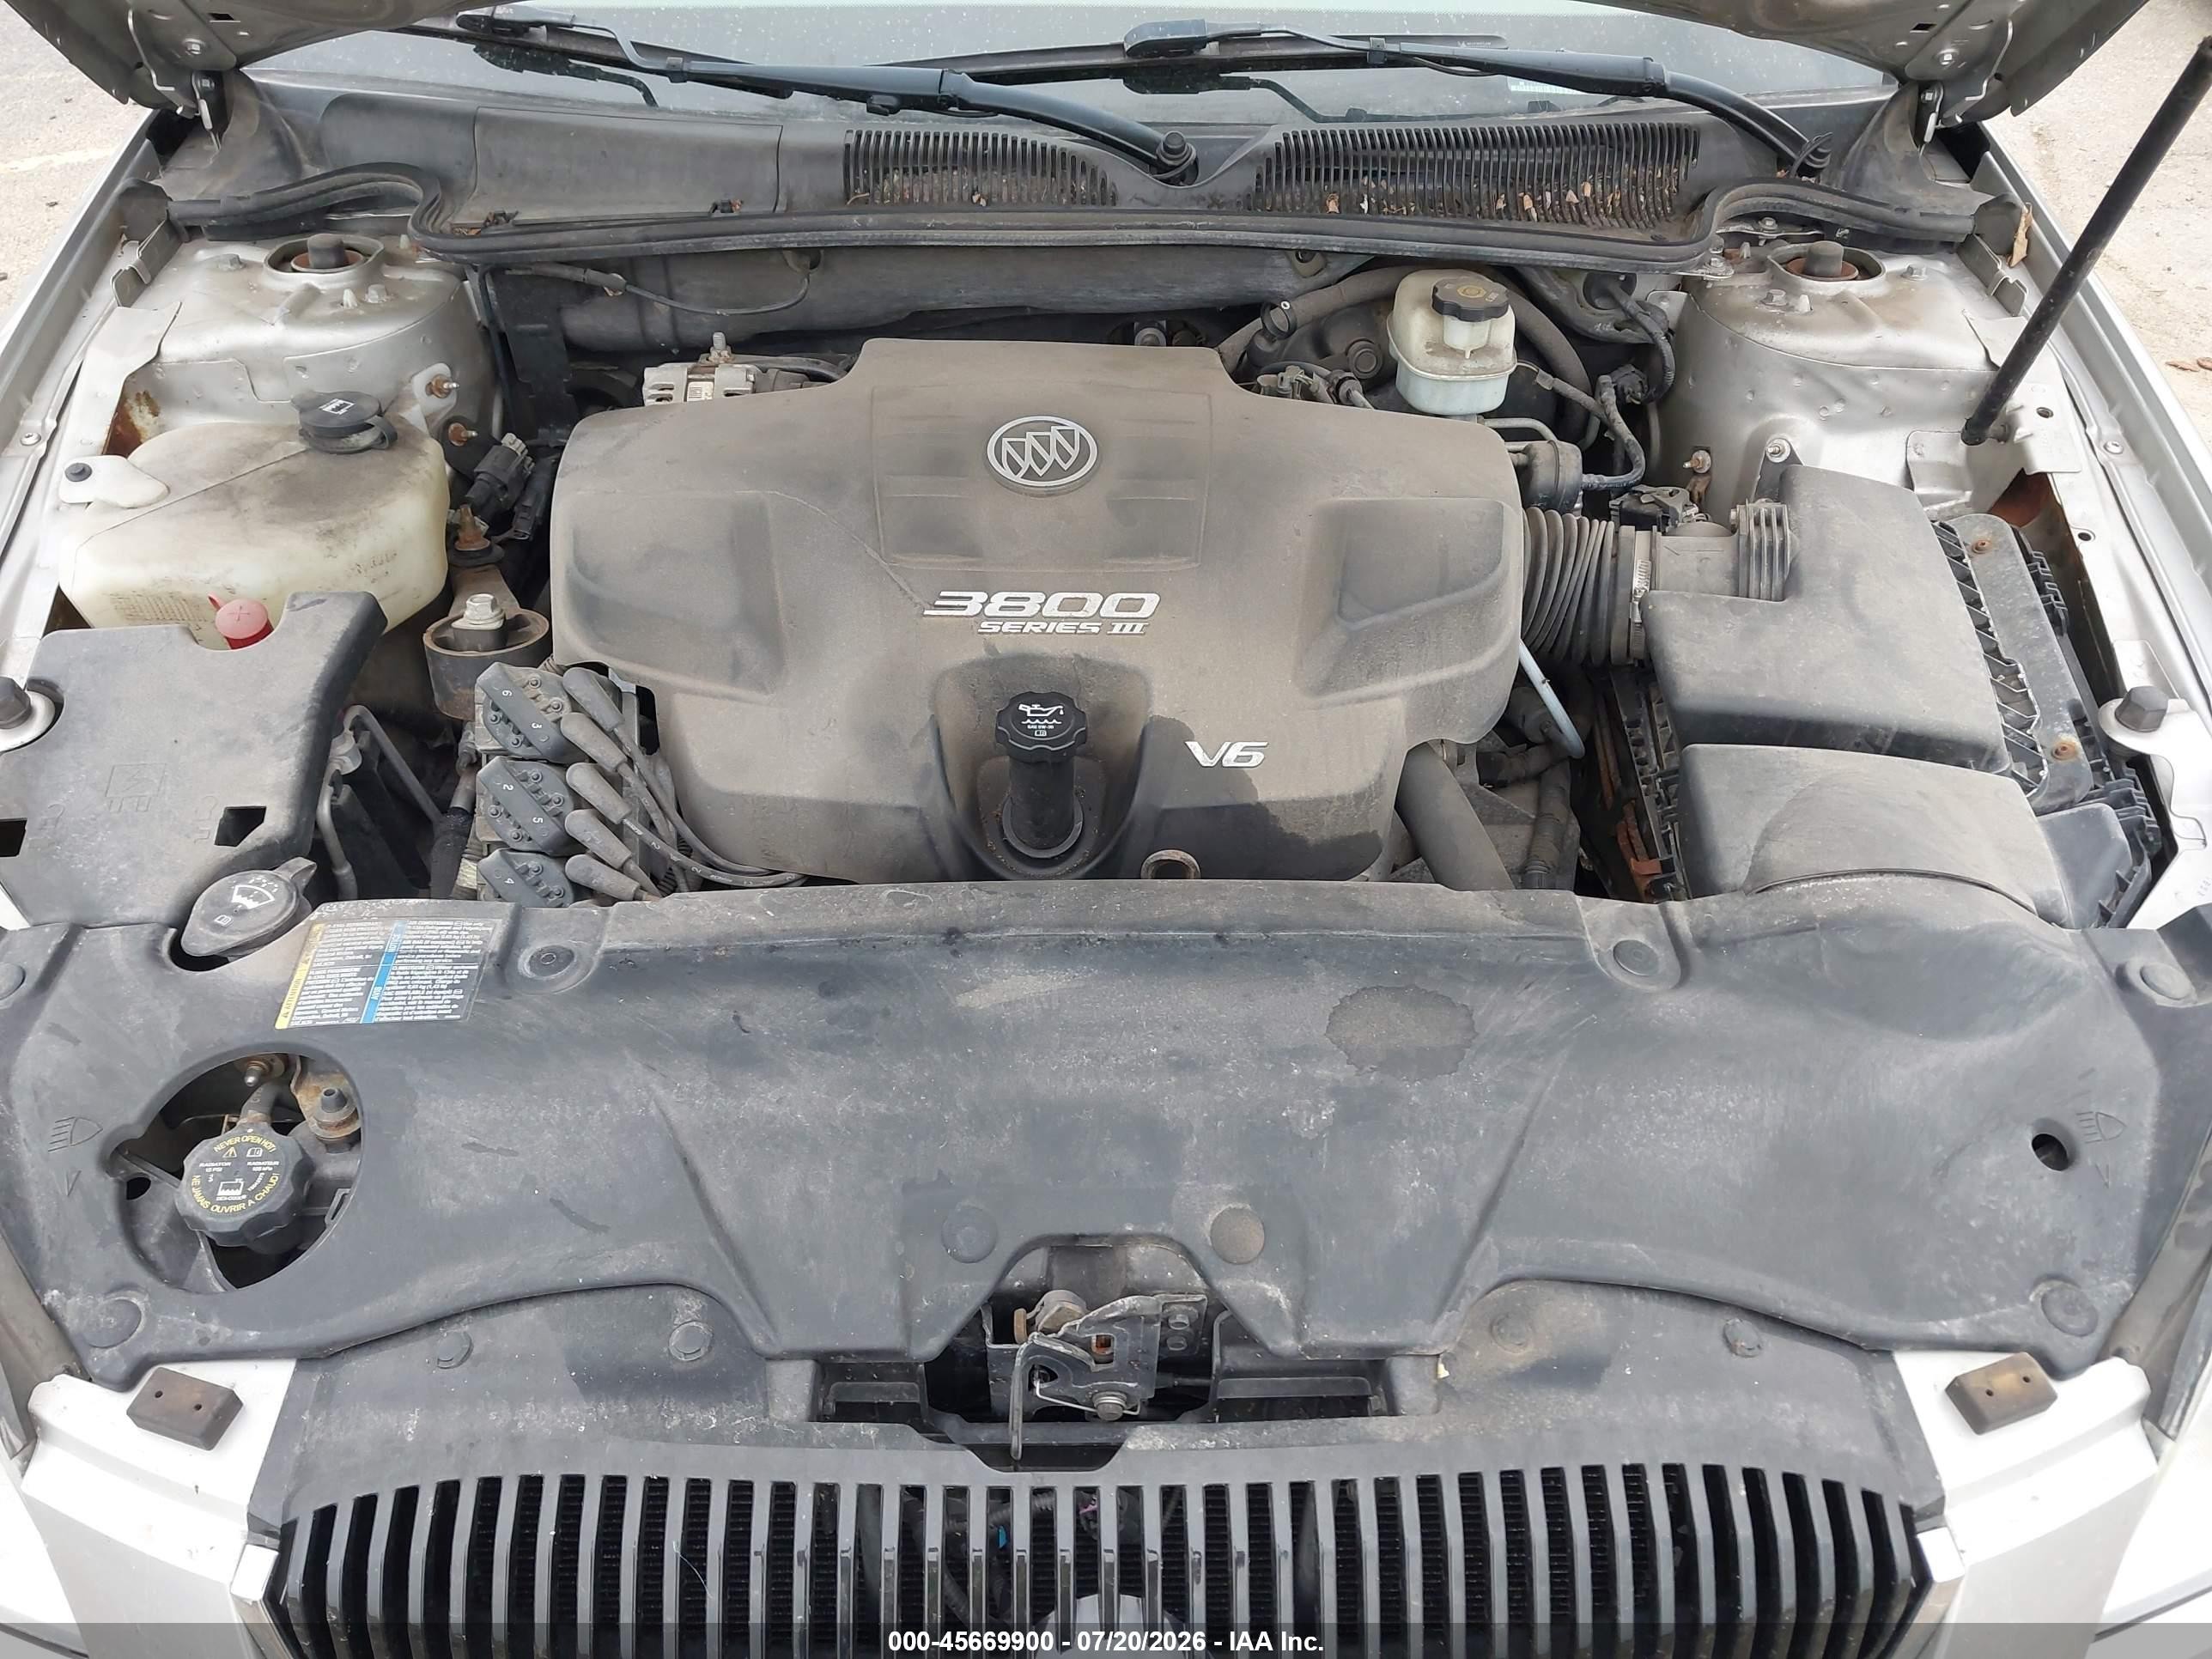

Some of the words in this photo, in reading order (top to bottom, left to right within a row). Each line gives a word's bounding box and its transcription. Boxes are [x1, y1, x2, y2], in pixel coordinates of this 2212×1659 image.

[923, 591, 1160, 618] 3800
[977, 621, 1103, 635] SERIES
[1106, 622, 1150, 635] III
[1184, 741, 1268, 768] V6
[388, 933, 401, 953] NOTICE
[371, 986, 383, 1000] AVIS
[214, 1135, 241, 1152] NEVER
[240, 1134, 262, 1144] OPEN
[261, 1136, 277, 1153] HOT!
[191, 1175, 202, 1186] NE
[254, 1172, 281, 1202] CHAUD!
[192, 1187, 210, 1210] JAMAIS
[210, 1202, 246, 1213] OUVRIR
